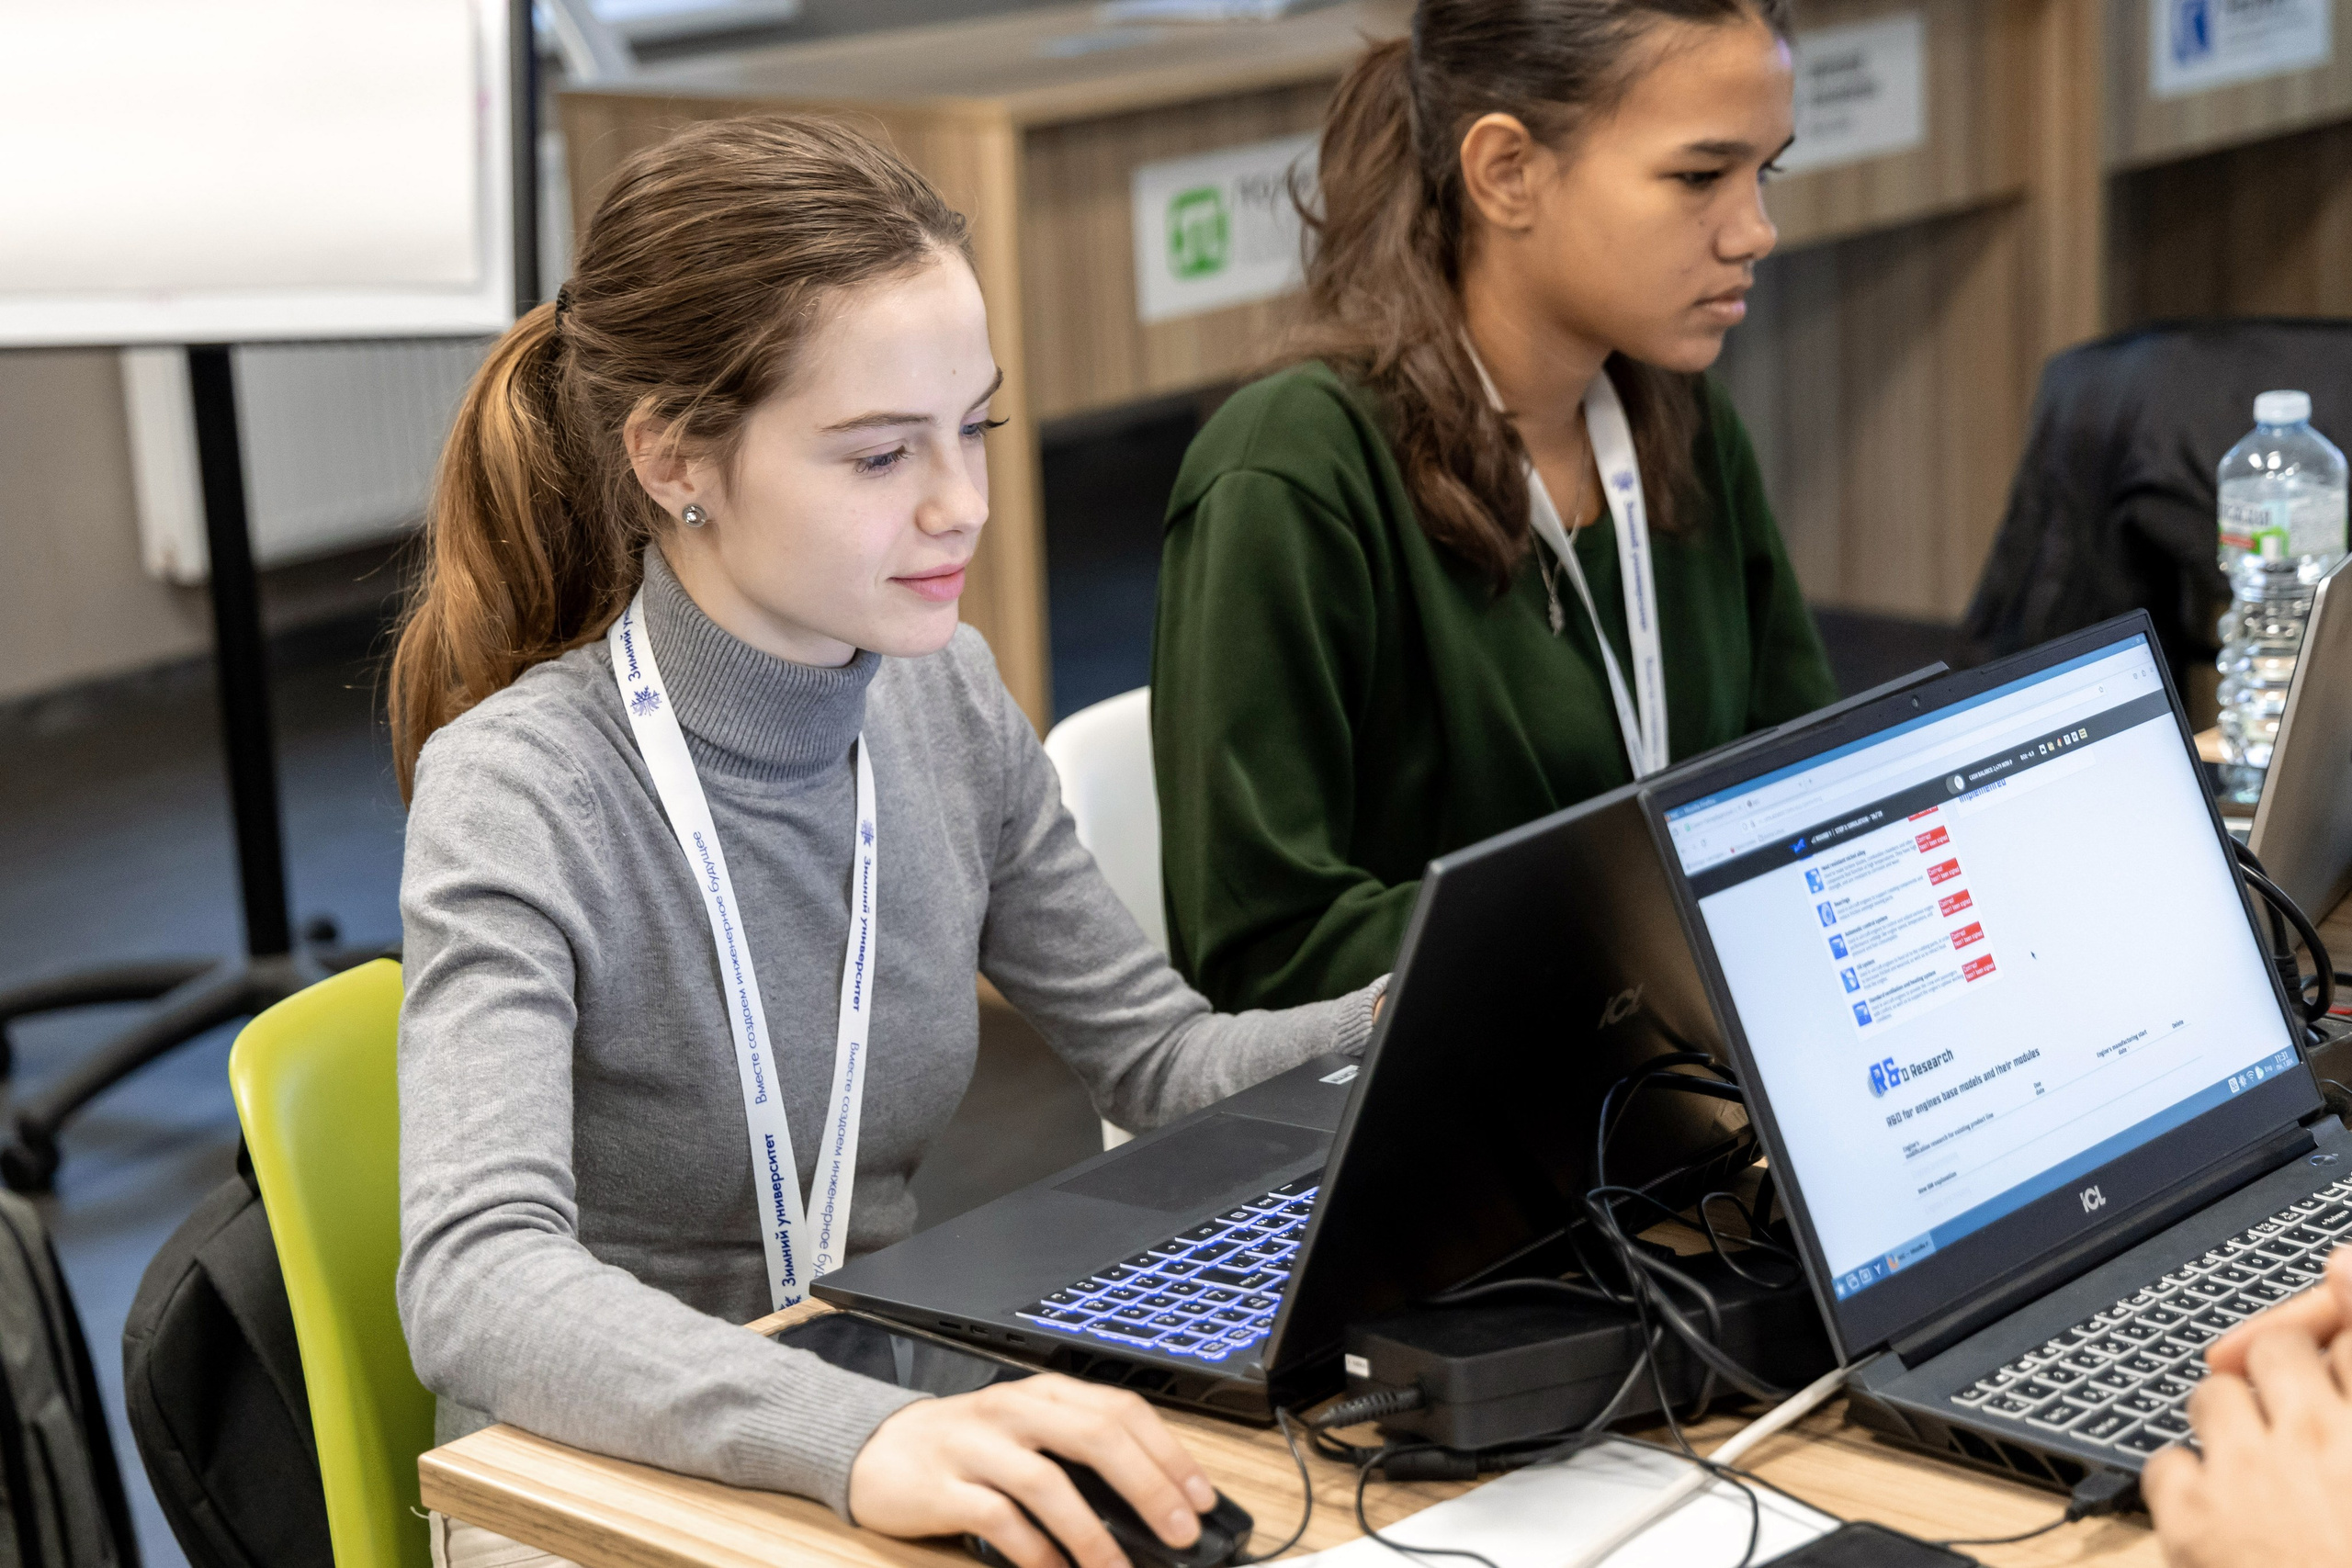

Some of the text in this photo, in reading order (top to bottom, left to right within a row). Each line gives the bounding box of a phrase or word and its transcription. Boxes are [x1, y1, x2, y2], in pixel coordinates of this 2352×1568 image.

[620, 629, 641, 682] Зимний
[693, 830, 768, 1105] Вместе создаем инженерное будущее
[853, 855, 872, 1012] Зимний университет
[844, 1042, 860, 1092] Вместе
[1901, 1108, 1914, 1120] for
[1915, 1095, 1942, 1114] engines
[1940, 1087, 1959, 1101] base
[1958, 1075, 1983, 1092] models
[1983, 1067, 1996, 1081] and
[1995, 1061, 2012, 1075] their
[2012, 1048, 2041, 1066] modules
[1909, 1049, 1954, 1077] Research
[833, 1096, 850, 1156] создаем
[764, 1134, 797, 1287] Зимний университет
[819, 1160, 841, 1249] инженерное
